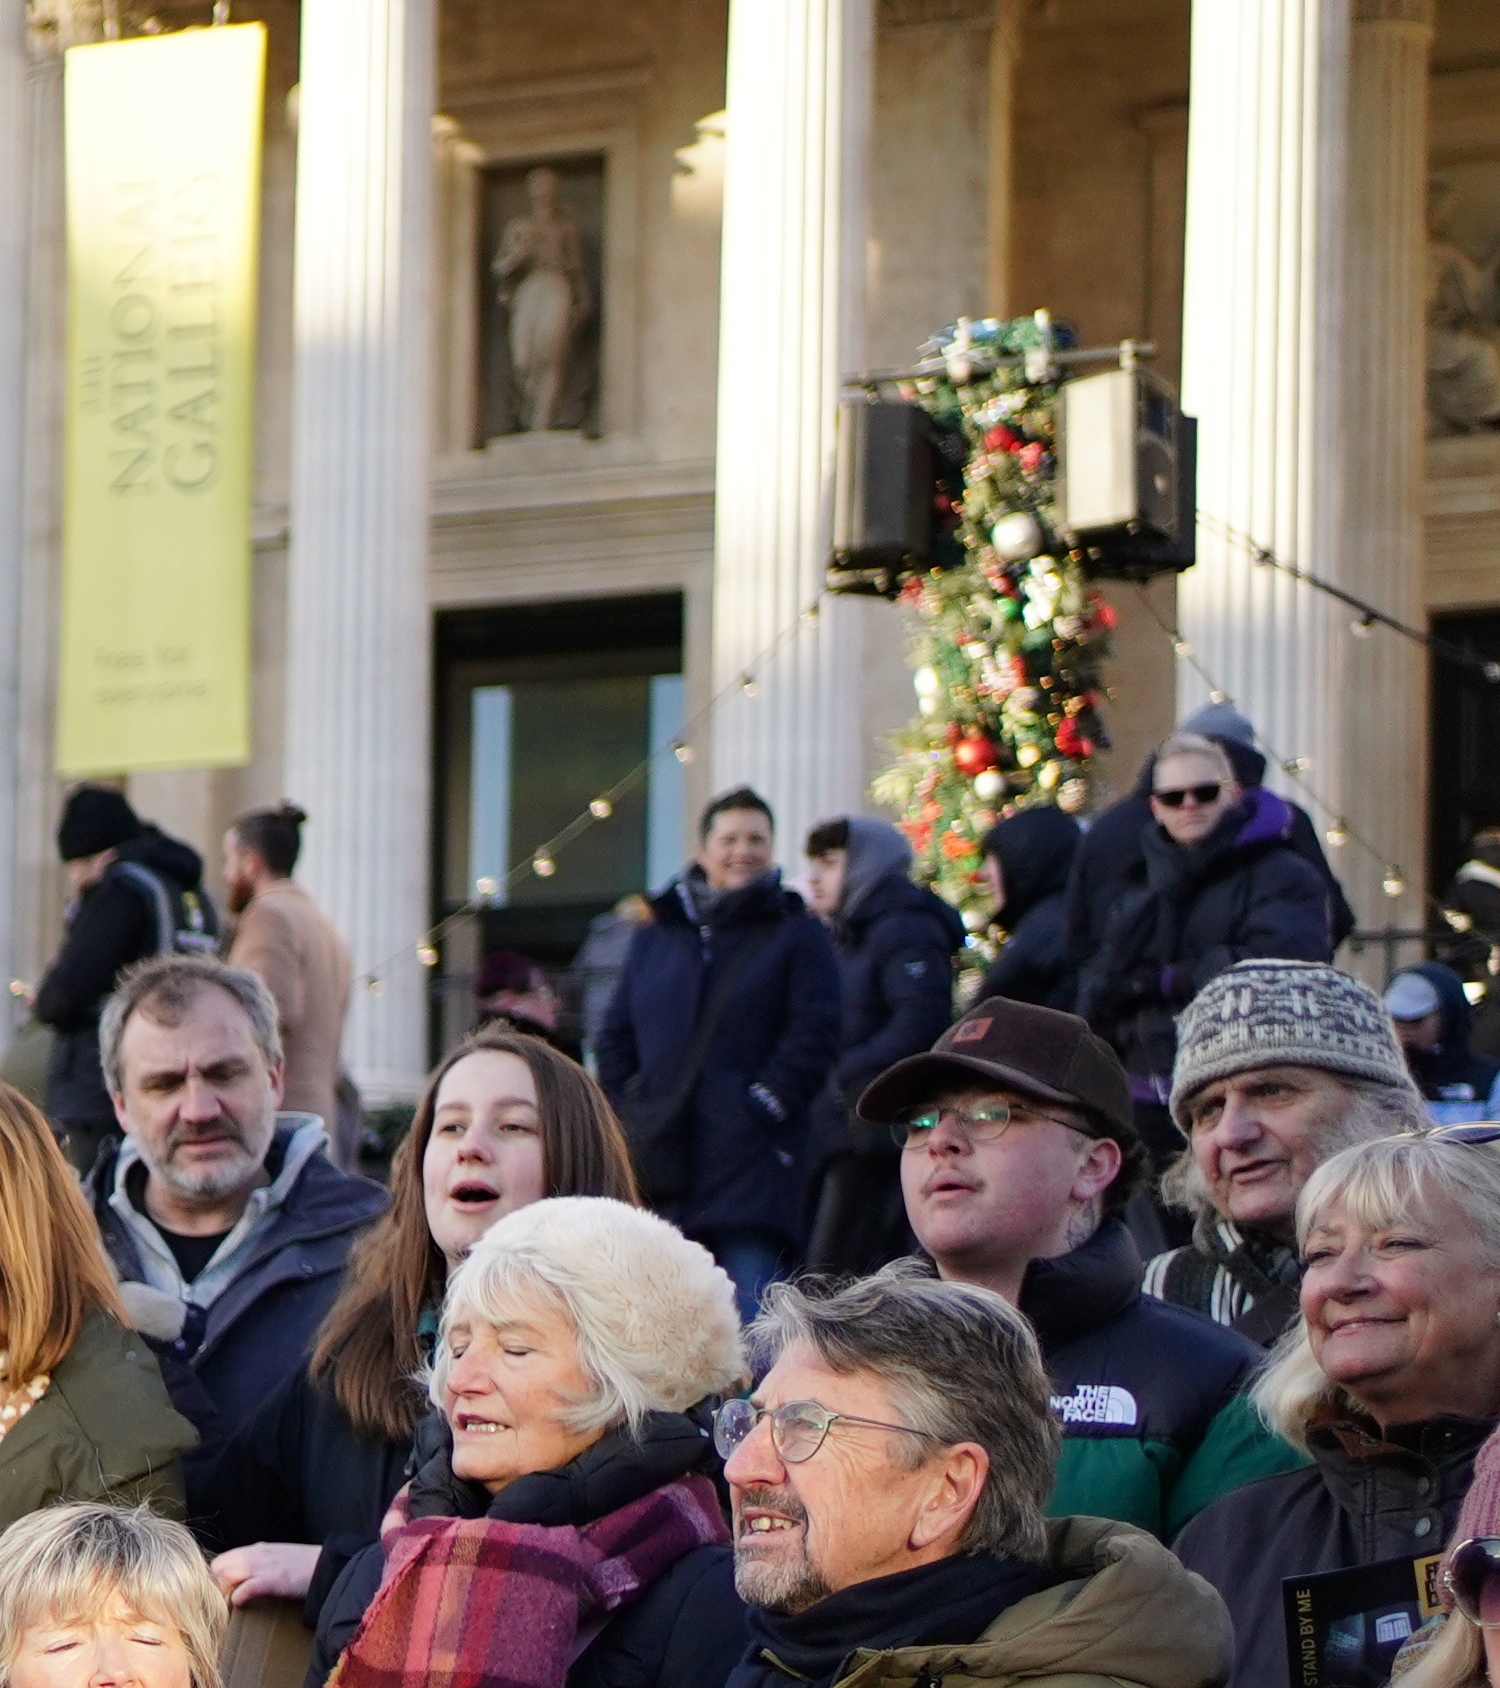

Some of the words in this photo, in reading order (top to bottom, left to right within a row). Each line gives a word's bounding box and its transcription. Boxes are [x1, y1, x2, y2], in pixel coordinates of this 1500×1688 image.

[1076, 1384, 1109, 1397] THE
[1049, 1395, 1107, 1410] NORTH
[1063, 1407, 1106, 1423] FACE
[1297, 1588, 1311, 1612] ME
[1299, 1613, 1315, 1635] BY
[1301, 1638, 1318, 1687] STAND
